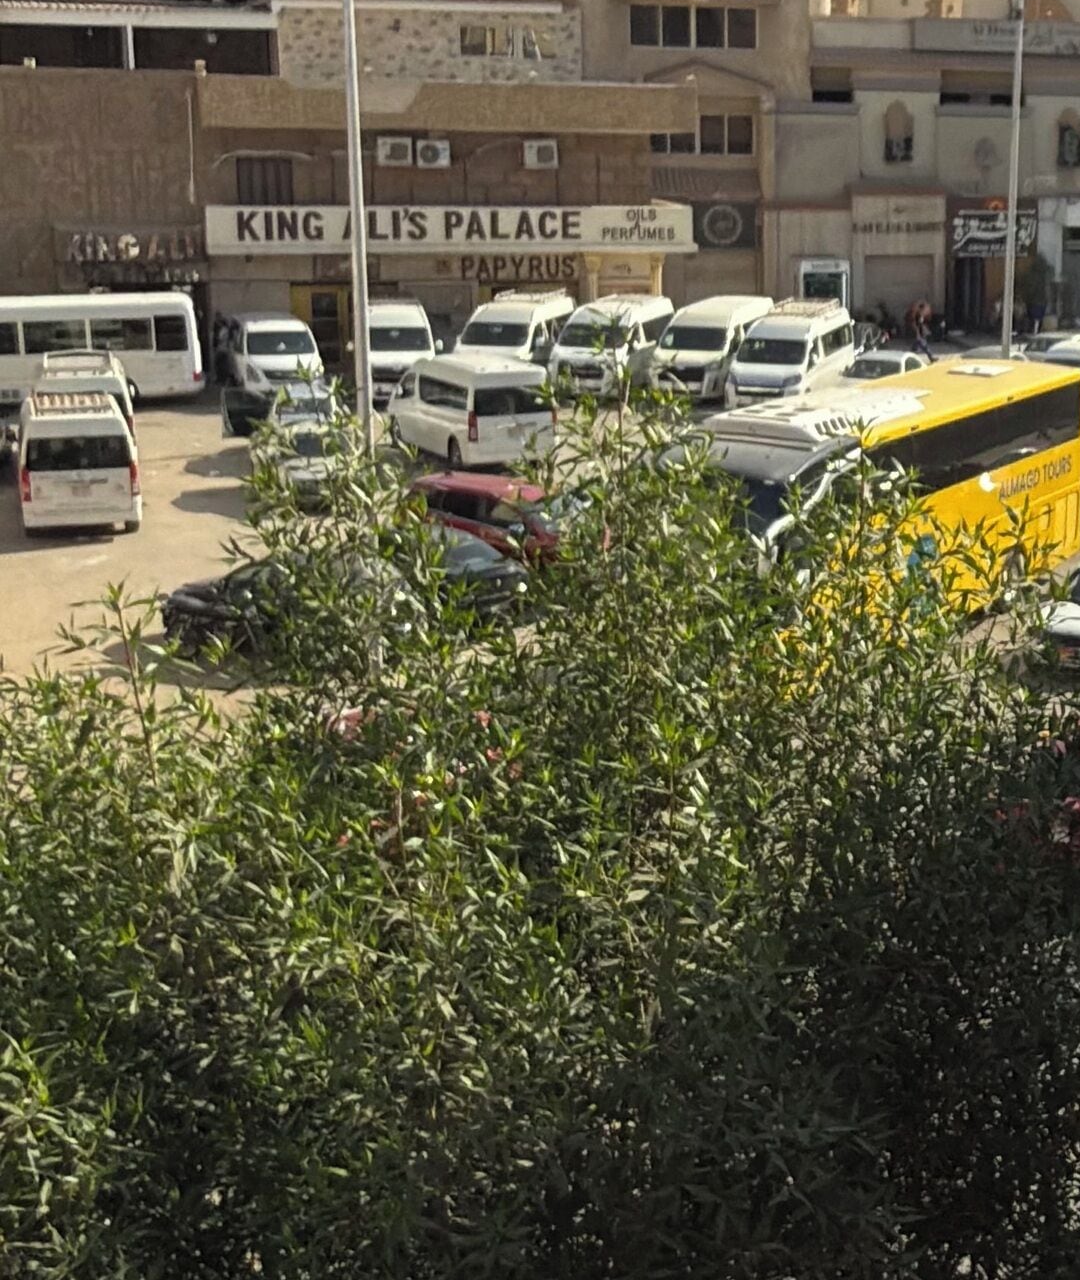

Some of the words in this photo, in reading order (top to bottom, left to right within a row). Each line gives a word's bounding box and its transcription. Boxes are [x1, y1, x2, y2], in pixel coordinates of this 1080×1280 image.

[236, 210, 325, 241] KING
[444, 210, 582, 241] PALACE
[602, 226, 675, 241] PERFUMES
[460, 254, 576, 281] PAPYRUS
[1042, 453, 1072, 484] TOURS
